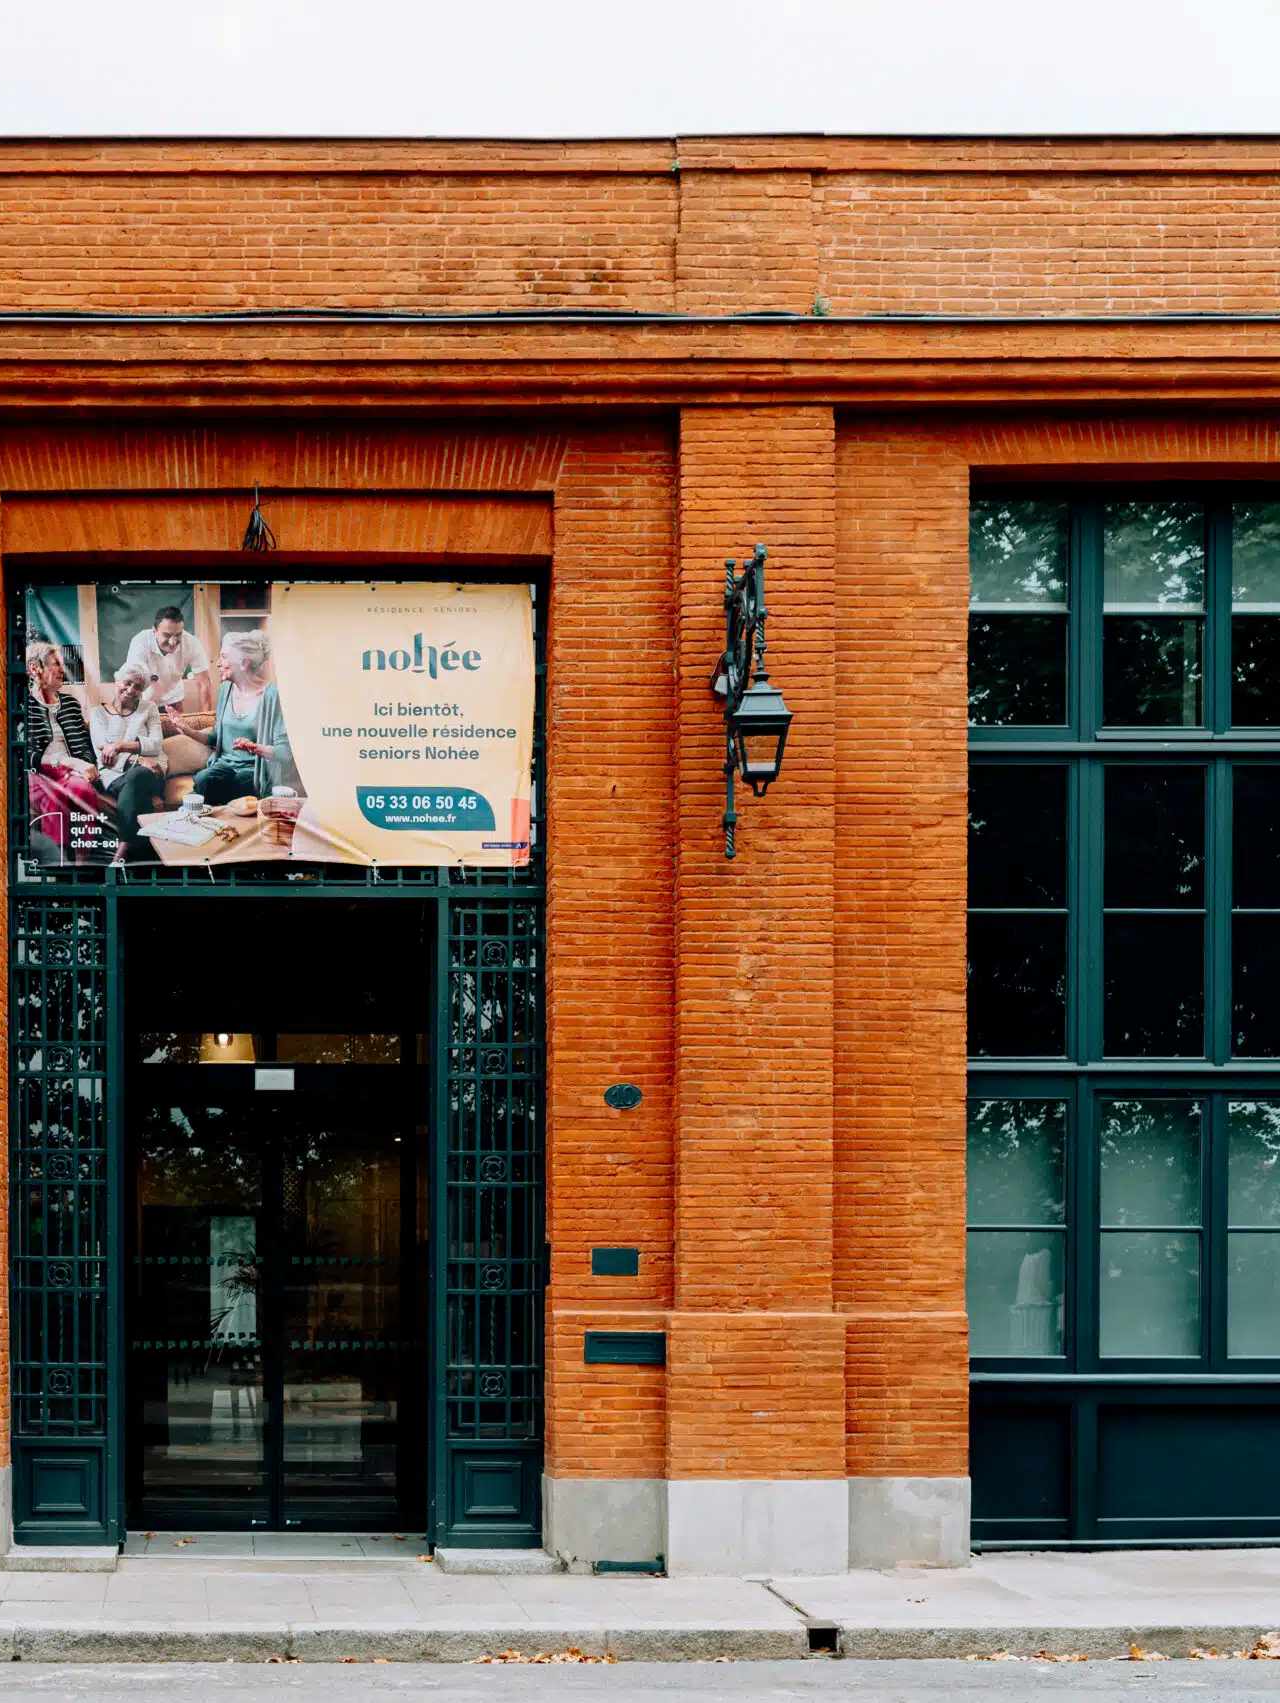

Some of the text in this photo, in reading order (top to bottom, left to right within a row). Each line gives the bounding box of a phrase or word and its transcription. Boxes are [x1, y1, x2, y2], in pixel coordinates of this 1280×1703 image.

[367, 605, 423, 613] RÉSIDENCE
[361, 632, 482, 680] nohée
[373, 702, 464, 719] Ici bientôt,
[322, 724, 517, 739] une nouvelle résidence
[359, 746, 480, 760] seniors Nohée
[366, 795, 477, 810] 05 33 06 50 45
[70, 812, 95, 823] Bien
[385, 813, 456, 823] www.nohee.fr
[70, 824, 102, 836] qu'un
[71, 838, 120, 849] chez-soi
